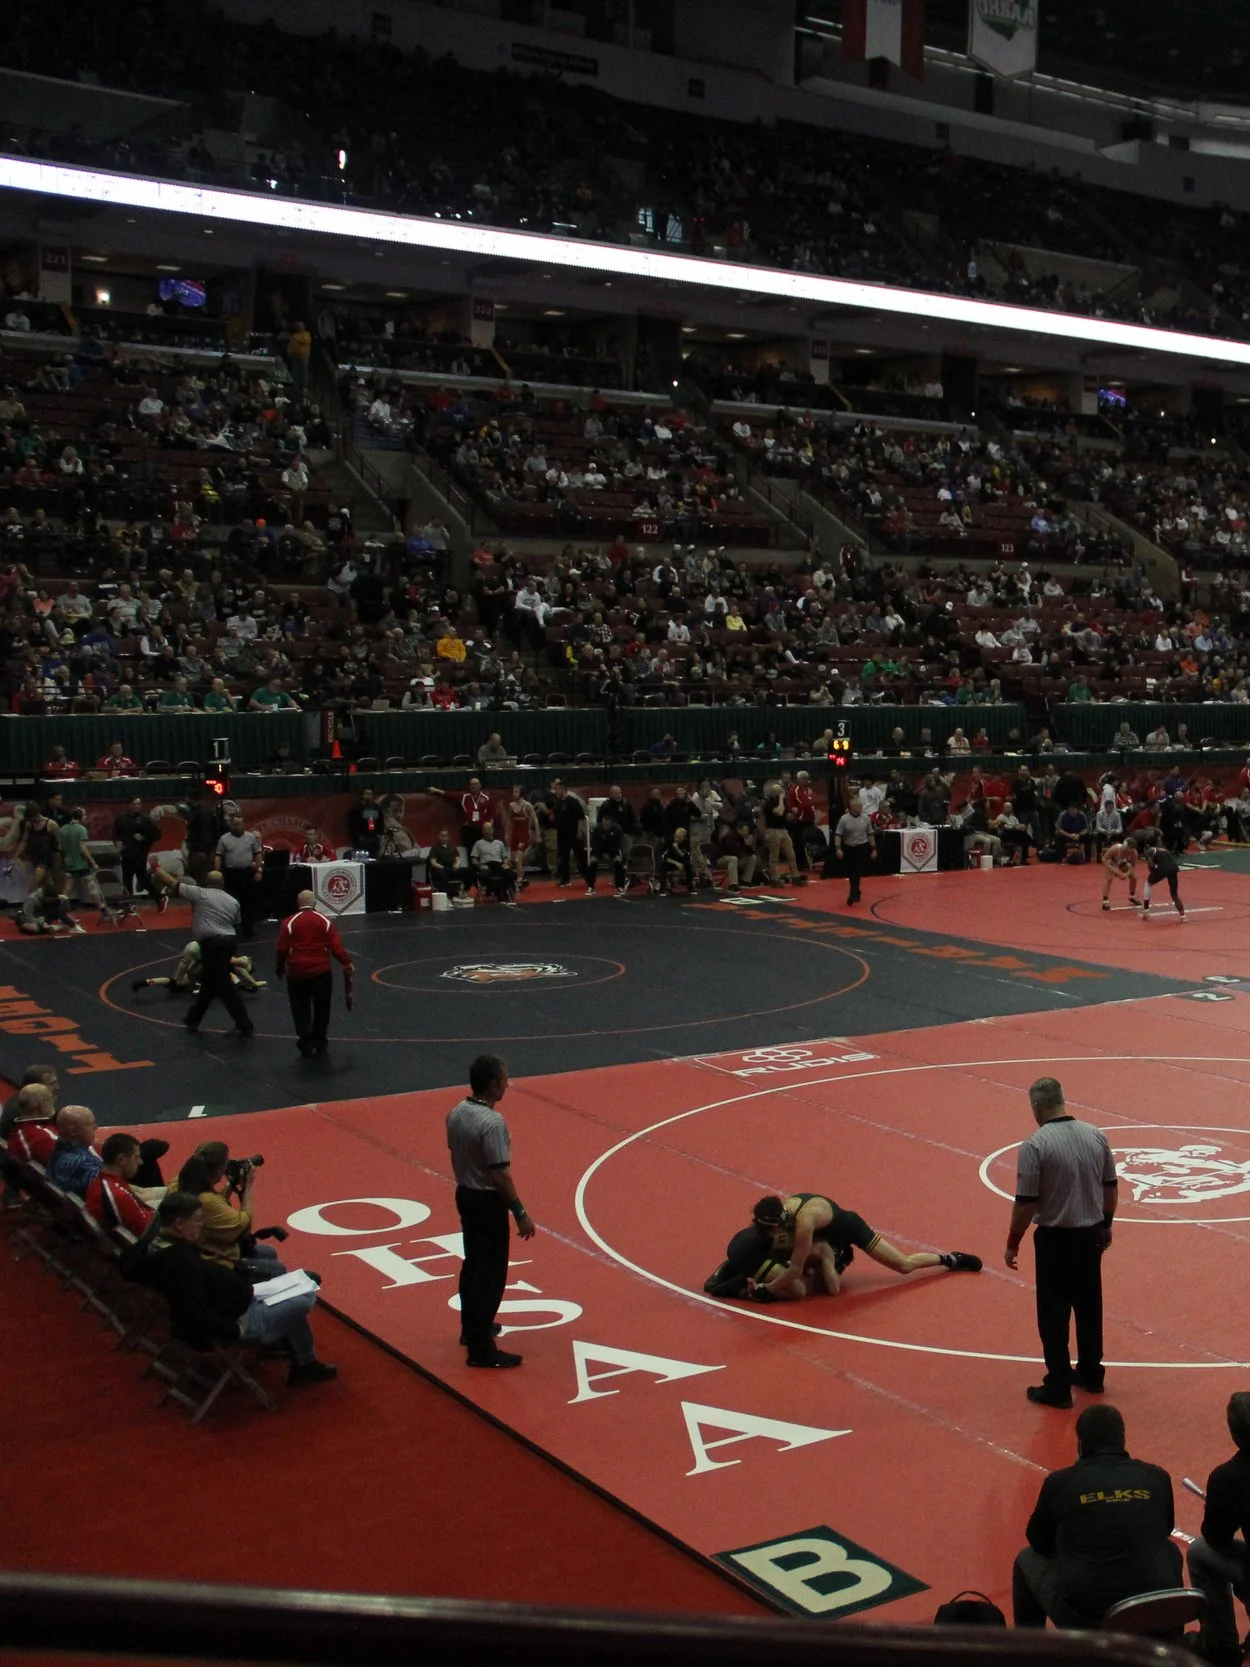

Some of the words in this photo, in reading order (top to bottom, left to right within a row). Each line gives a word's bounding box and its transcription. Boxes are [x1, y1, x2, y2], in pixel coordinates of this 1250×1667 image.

[641, 524, 659, 534] 122
[327, 711, 335, 743] RECYCLE
[837, 722, 845, 737] 3
[732, 1052, 875, 1077] RUDIS
[286, 1197, 853, 1476] OHSAA
[1079, 1487, 1151, 1505] ELKS
[730, 1537, 893, 1613] B
